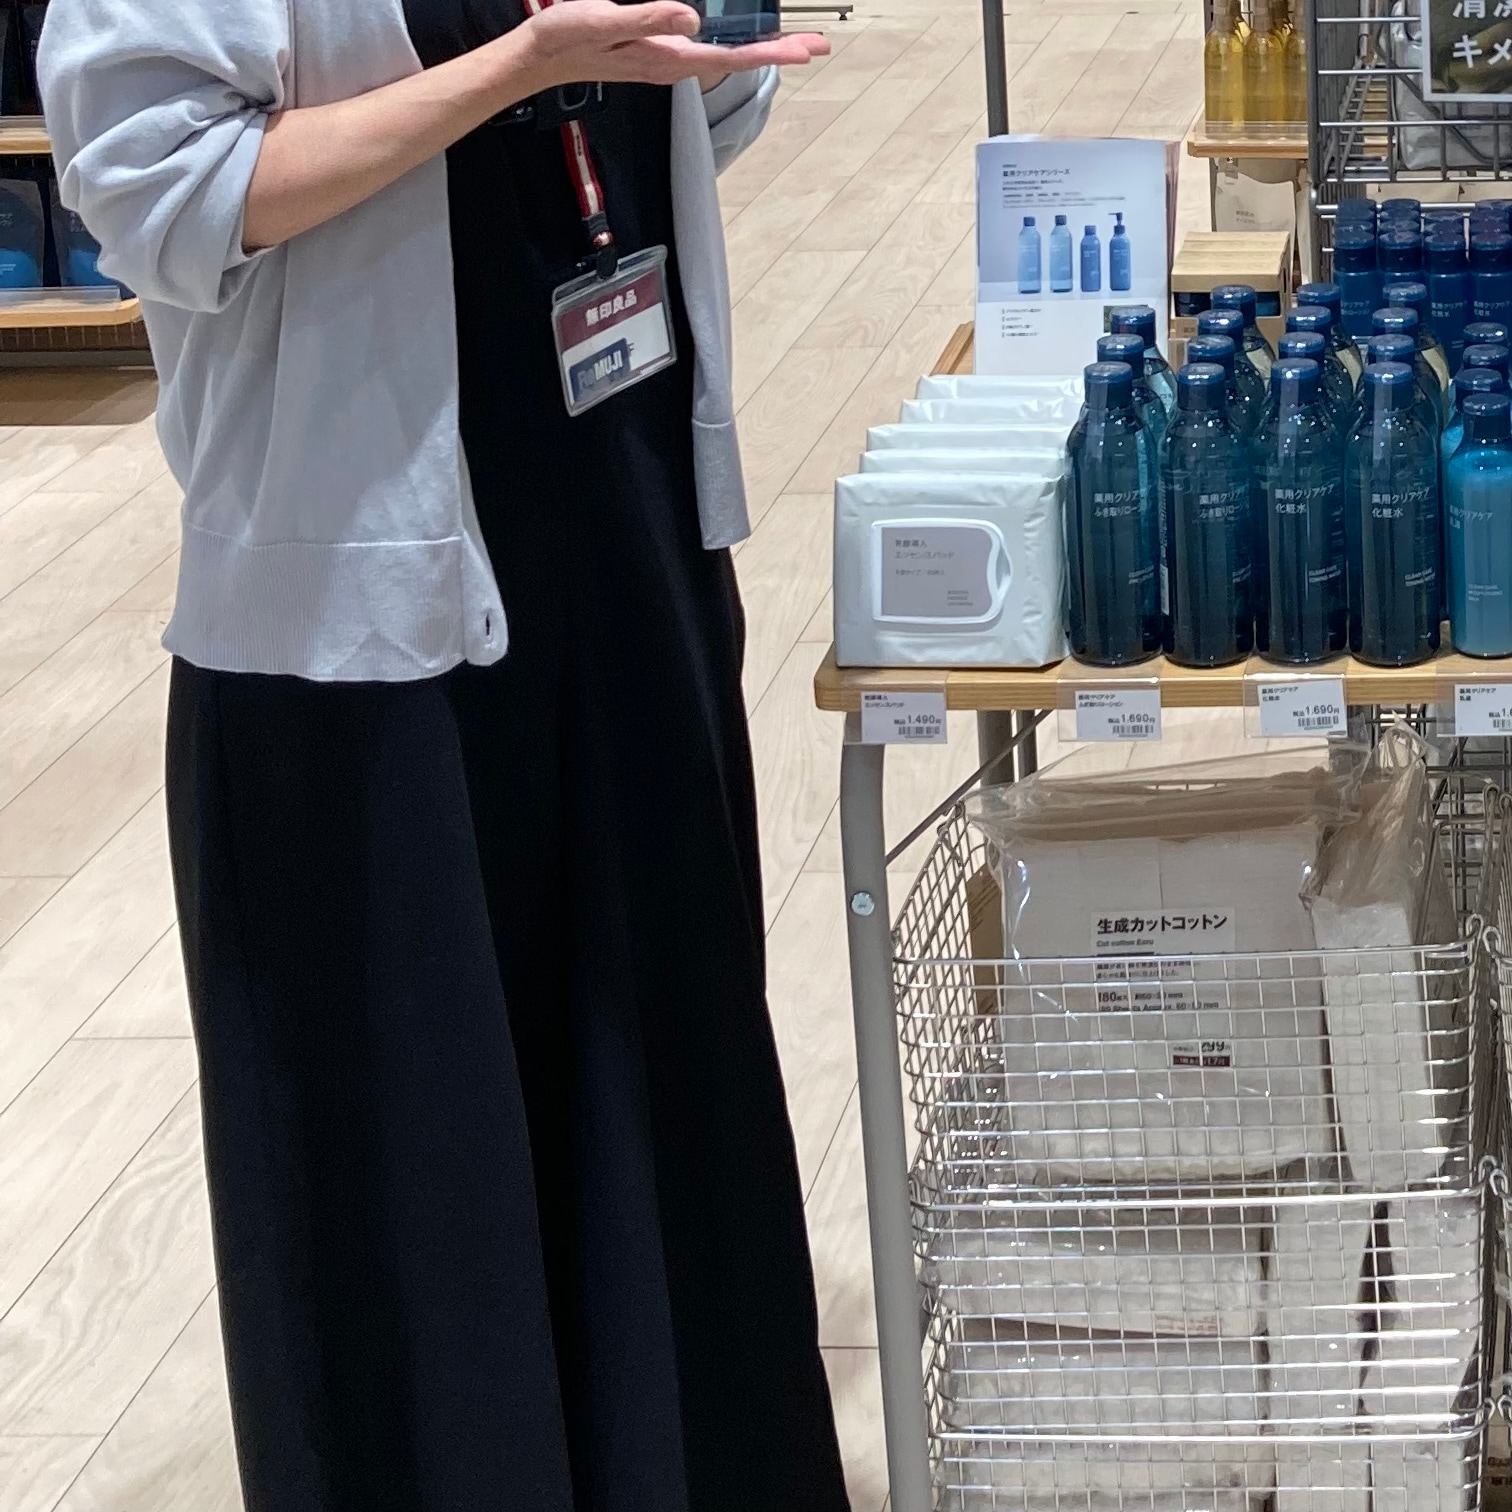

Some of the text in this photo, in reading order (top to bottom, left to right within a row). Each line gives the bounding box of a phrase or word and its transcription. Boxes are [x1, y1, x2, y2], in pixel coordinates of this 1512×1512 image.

[594, 350, 623, 381] MUJI
[1275, 484, 1335, 500] 薬用クリアケア
[1275, 503, 1307, 514] 化粧水
[1372, 507, 1404, 519] 化粧水
[1097, 914, 1228, 935] 生成カットコットン
